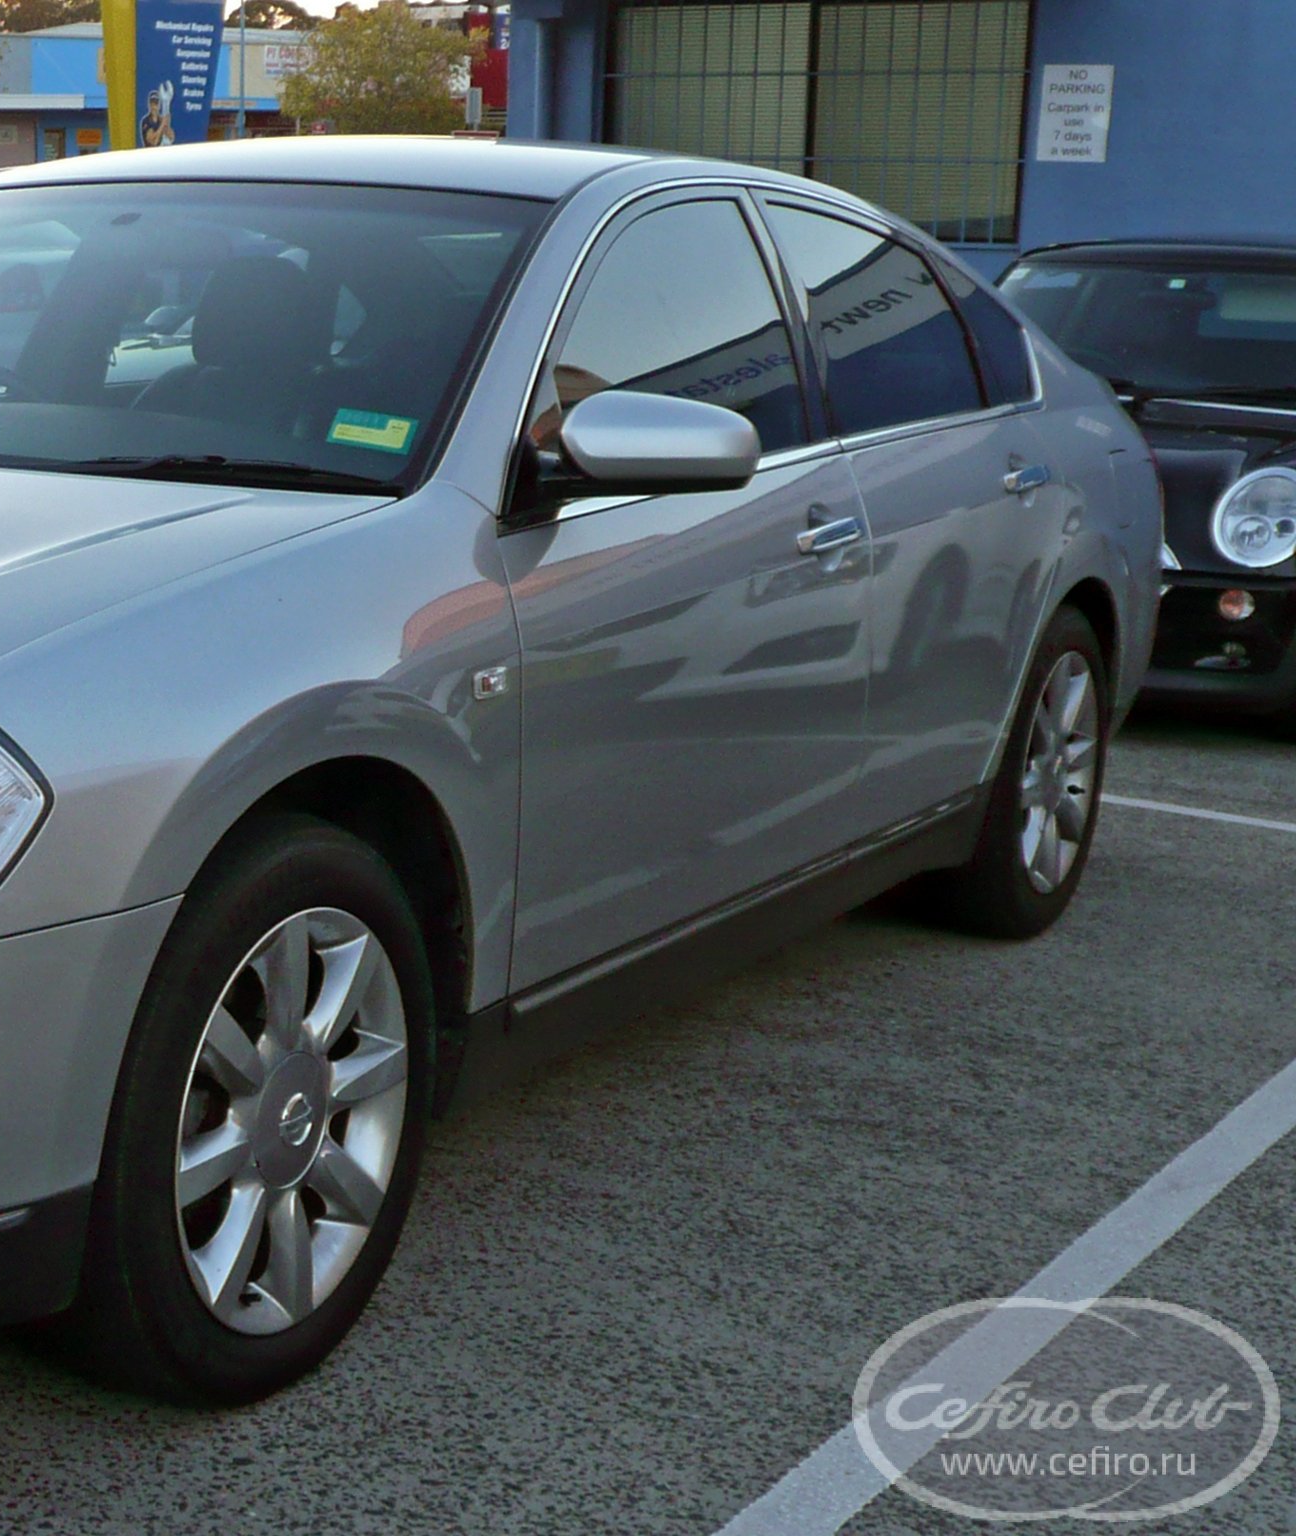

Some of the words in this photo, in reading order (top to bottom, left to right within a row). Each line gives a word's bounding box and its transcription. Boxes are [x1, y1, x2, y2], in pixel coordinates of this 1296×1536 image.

[172, 35, 183, 44] Car
[184, 36, 212, 47] Servicing
[1069, 69, 1088, 80] NO
[1049, 83, 1105, 95] PARKING
[1047, 102, 1090, 114] Carpark
[1094, 103, 1104, 113] in
[1064, 117, 1084, 127] use
[1054, 130, 1061, 141] 7
[1064, 131, 1092, 144] days
[1051, 147, 1058, 156] a
[1062, 146, 1092, 157] week
